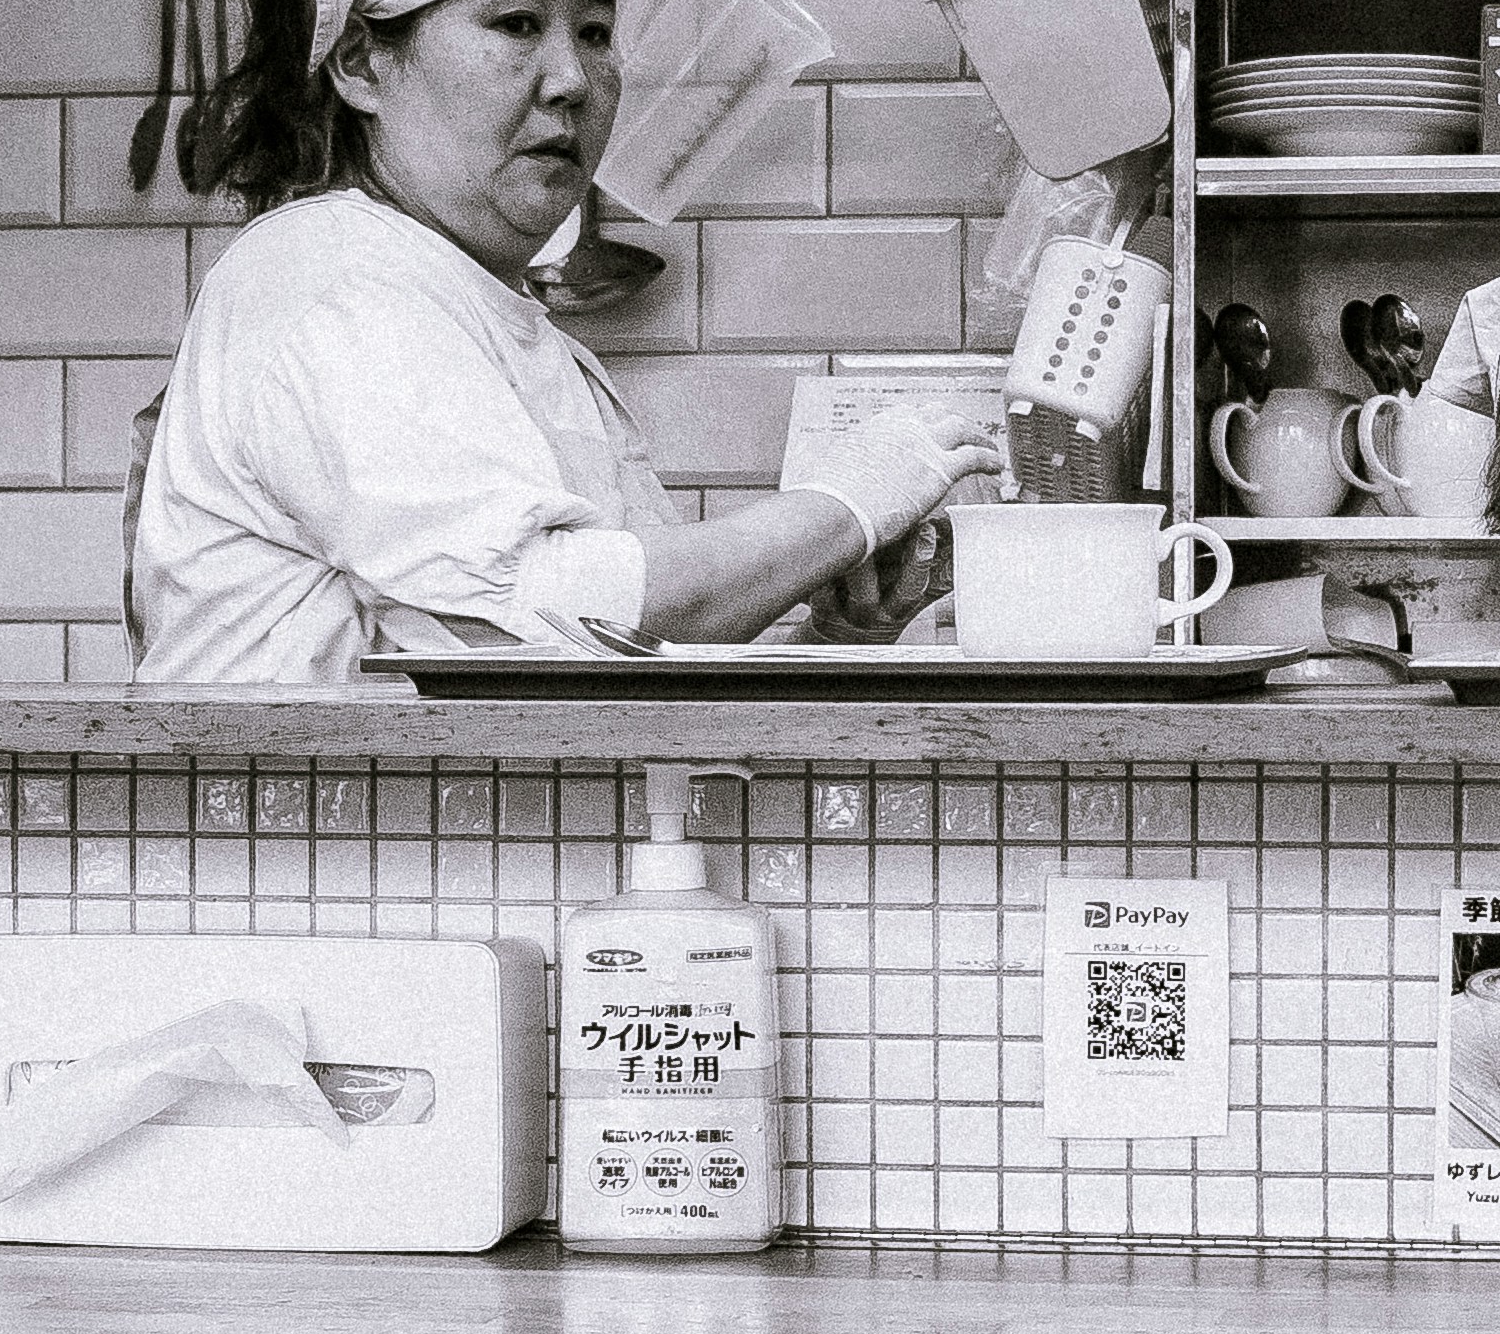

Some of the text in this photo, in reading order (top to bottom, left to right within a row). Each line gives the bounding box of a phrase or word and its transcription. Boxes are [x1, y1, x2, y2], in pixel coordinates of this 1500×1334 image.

[1115, 906, 1190, 928] PayPay
[580, 1021, 756, 1052] ウイルシャット
[617, 1055, 720, 1084] 手指用
